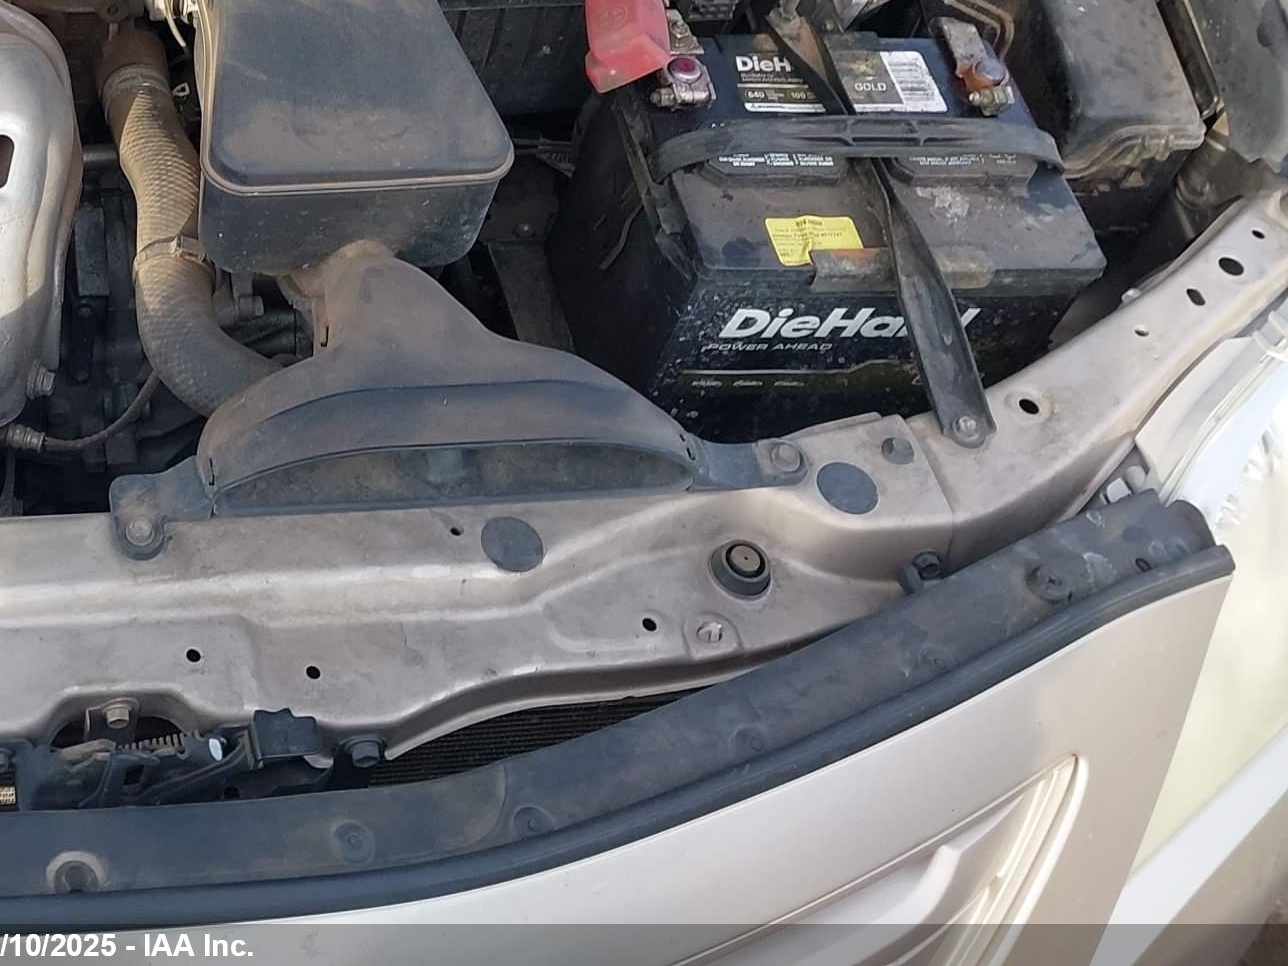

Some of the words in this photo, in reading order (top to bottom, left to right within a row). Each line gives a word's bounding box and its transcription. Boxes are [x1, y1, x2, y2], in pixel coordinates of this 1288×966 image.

[735, 55, 792, 72] DieH
[854, 82, 887, 92] GOLD
[718, 307, 982, 339] DieHa
[705, 342, 768, 352] POWER
[772, 342, 833, 352] AHEAD
